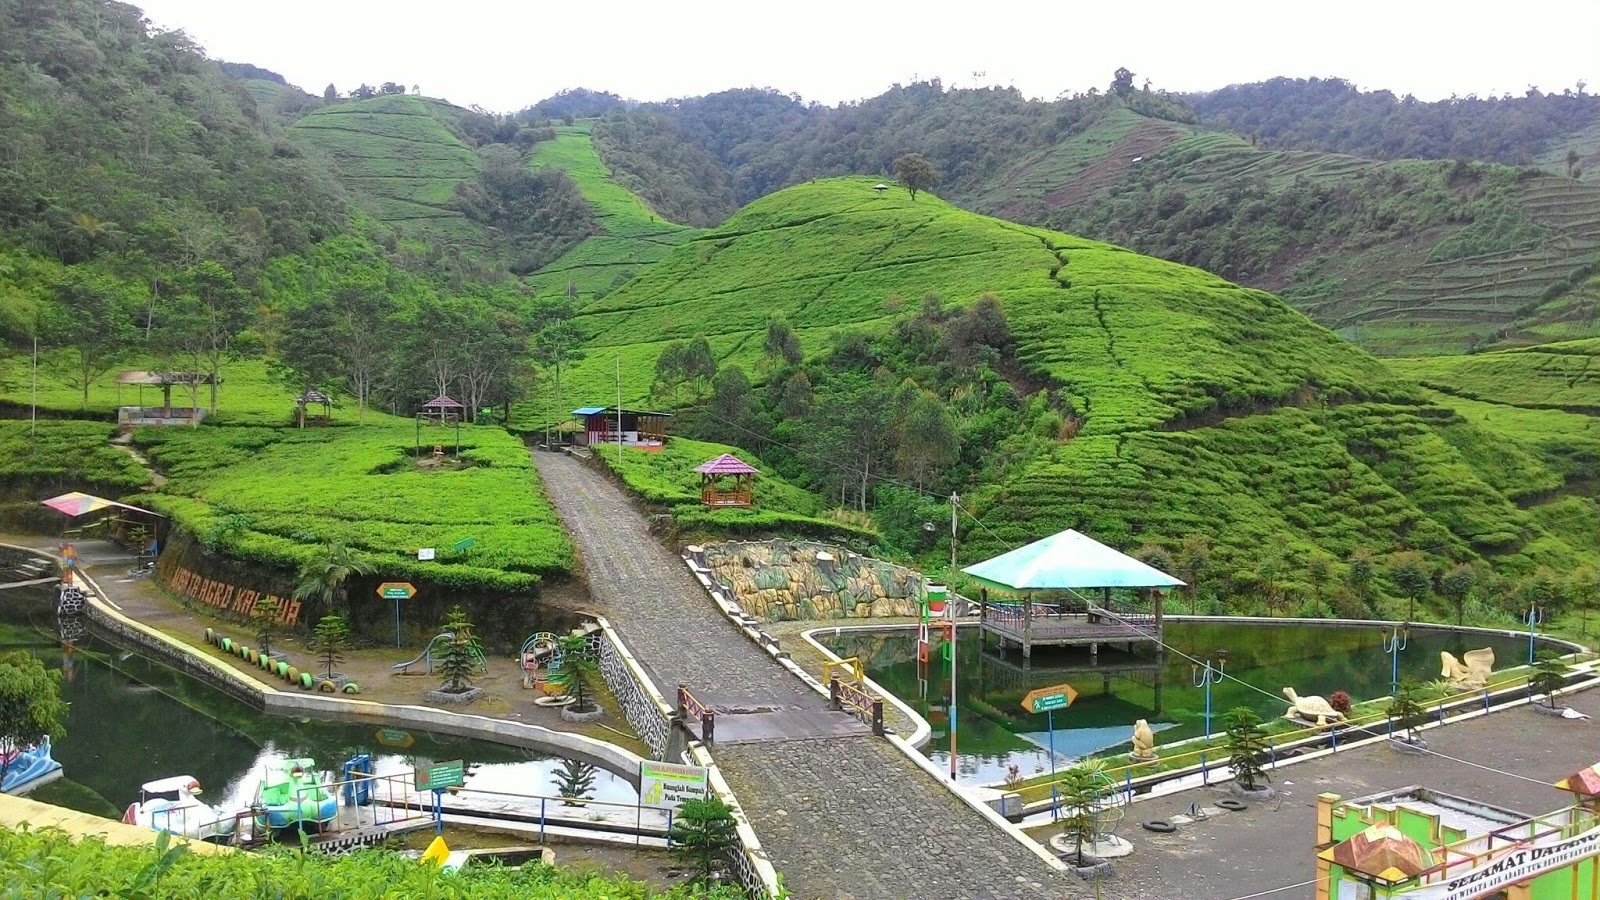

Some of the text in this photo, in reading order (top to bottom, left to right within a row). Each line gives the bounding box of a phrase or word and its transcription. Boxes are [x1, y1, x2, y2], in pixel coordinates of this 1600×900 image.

[200, 579, 235, 608] AGRO
[232, 587, 301, 625] KALUA
[1447, 852, 1526, 891] SELAMAT
